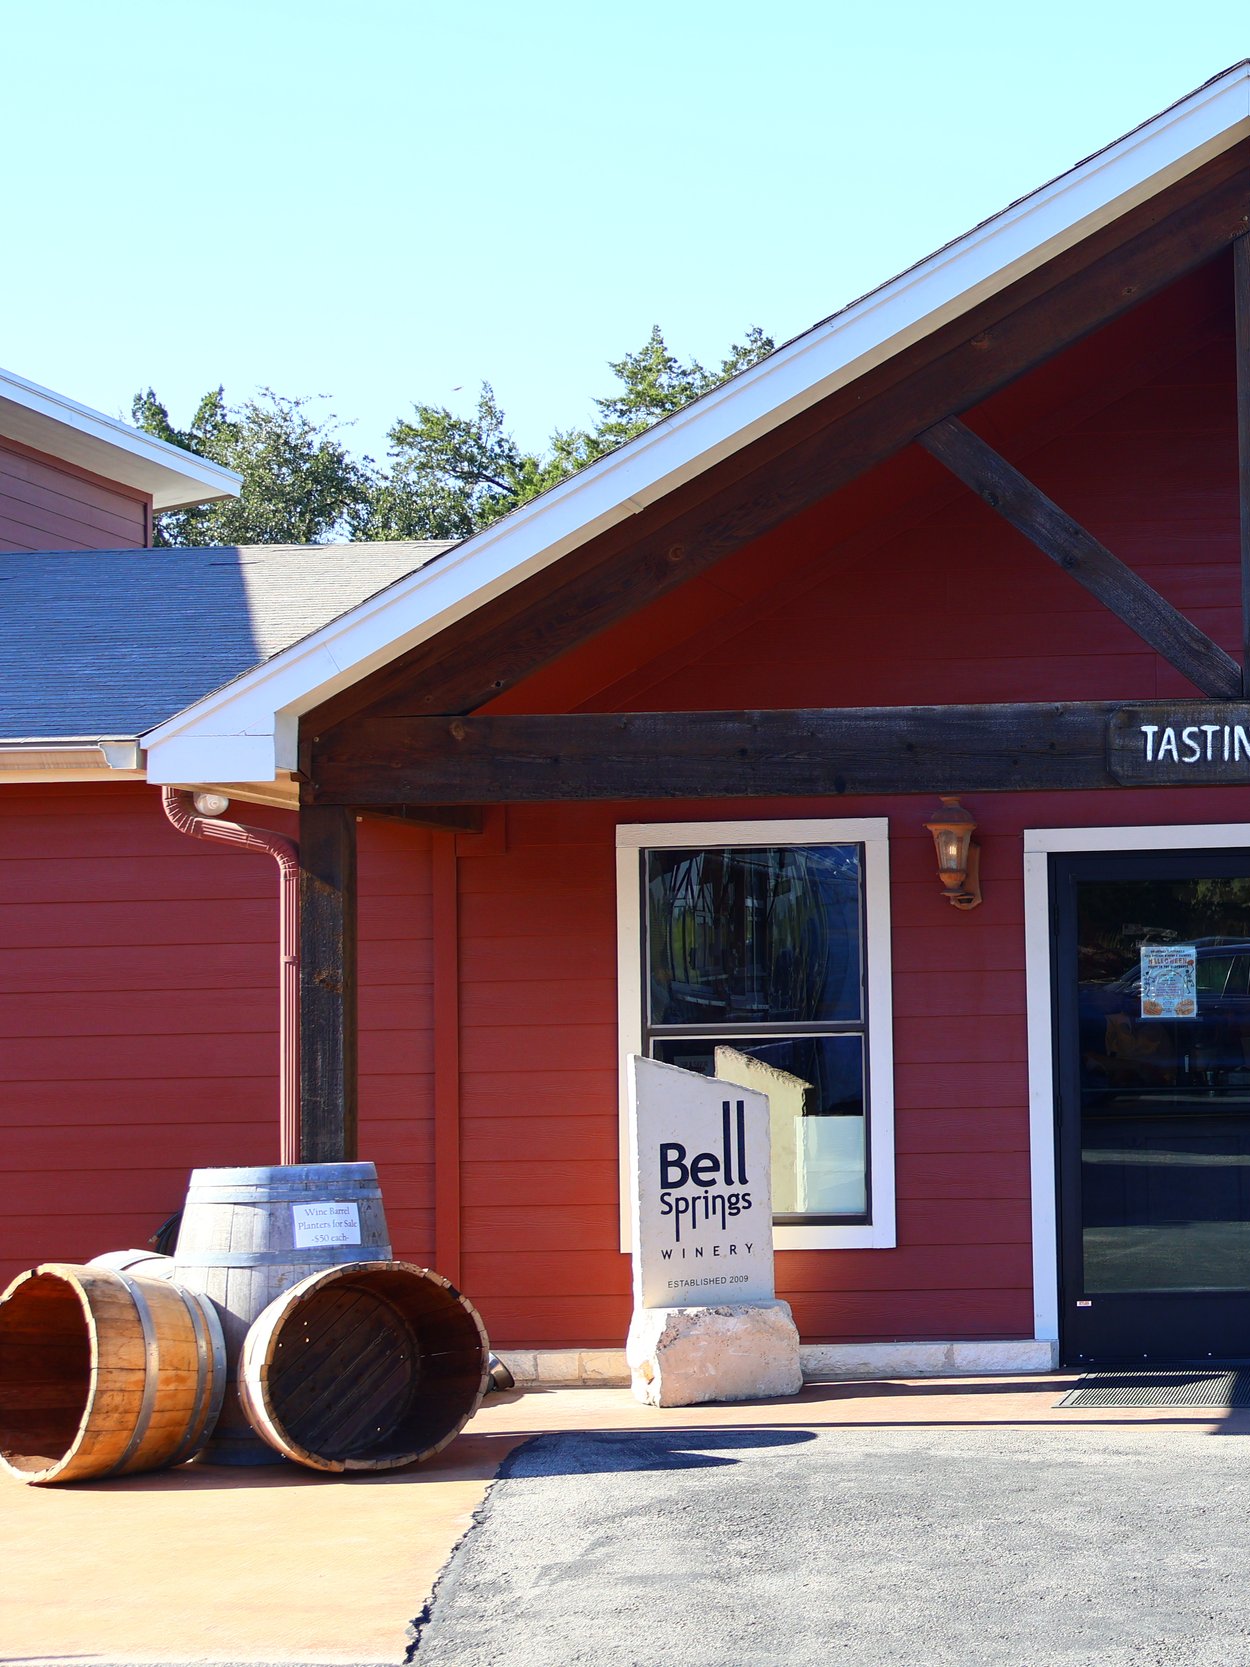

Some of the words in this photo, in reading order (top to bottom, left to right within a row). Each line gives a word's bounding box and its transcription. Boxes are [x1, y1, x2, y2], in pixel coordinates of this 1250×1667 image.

[659, 1100, 749, 1190] Bell
[304, 1208, 328, 1216] Wine
[329, 1206, 350, 1215] Barrel
[660, 1189, 752, 1242] Springs
[298, 1221, 331, 1230] Planters
[332, 1219, 343, 1228] for
[344, 1219, 358, 1228] Sale
[661, 1243, 753, 1260] WINERY
[667, 1276, 727, 1289] ESTABLISHED
[729, 1274, 749, 1284] 2009
